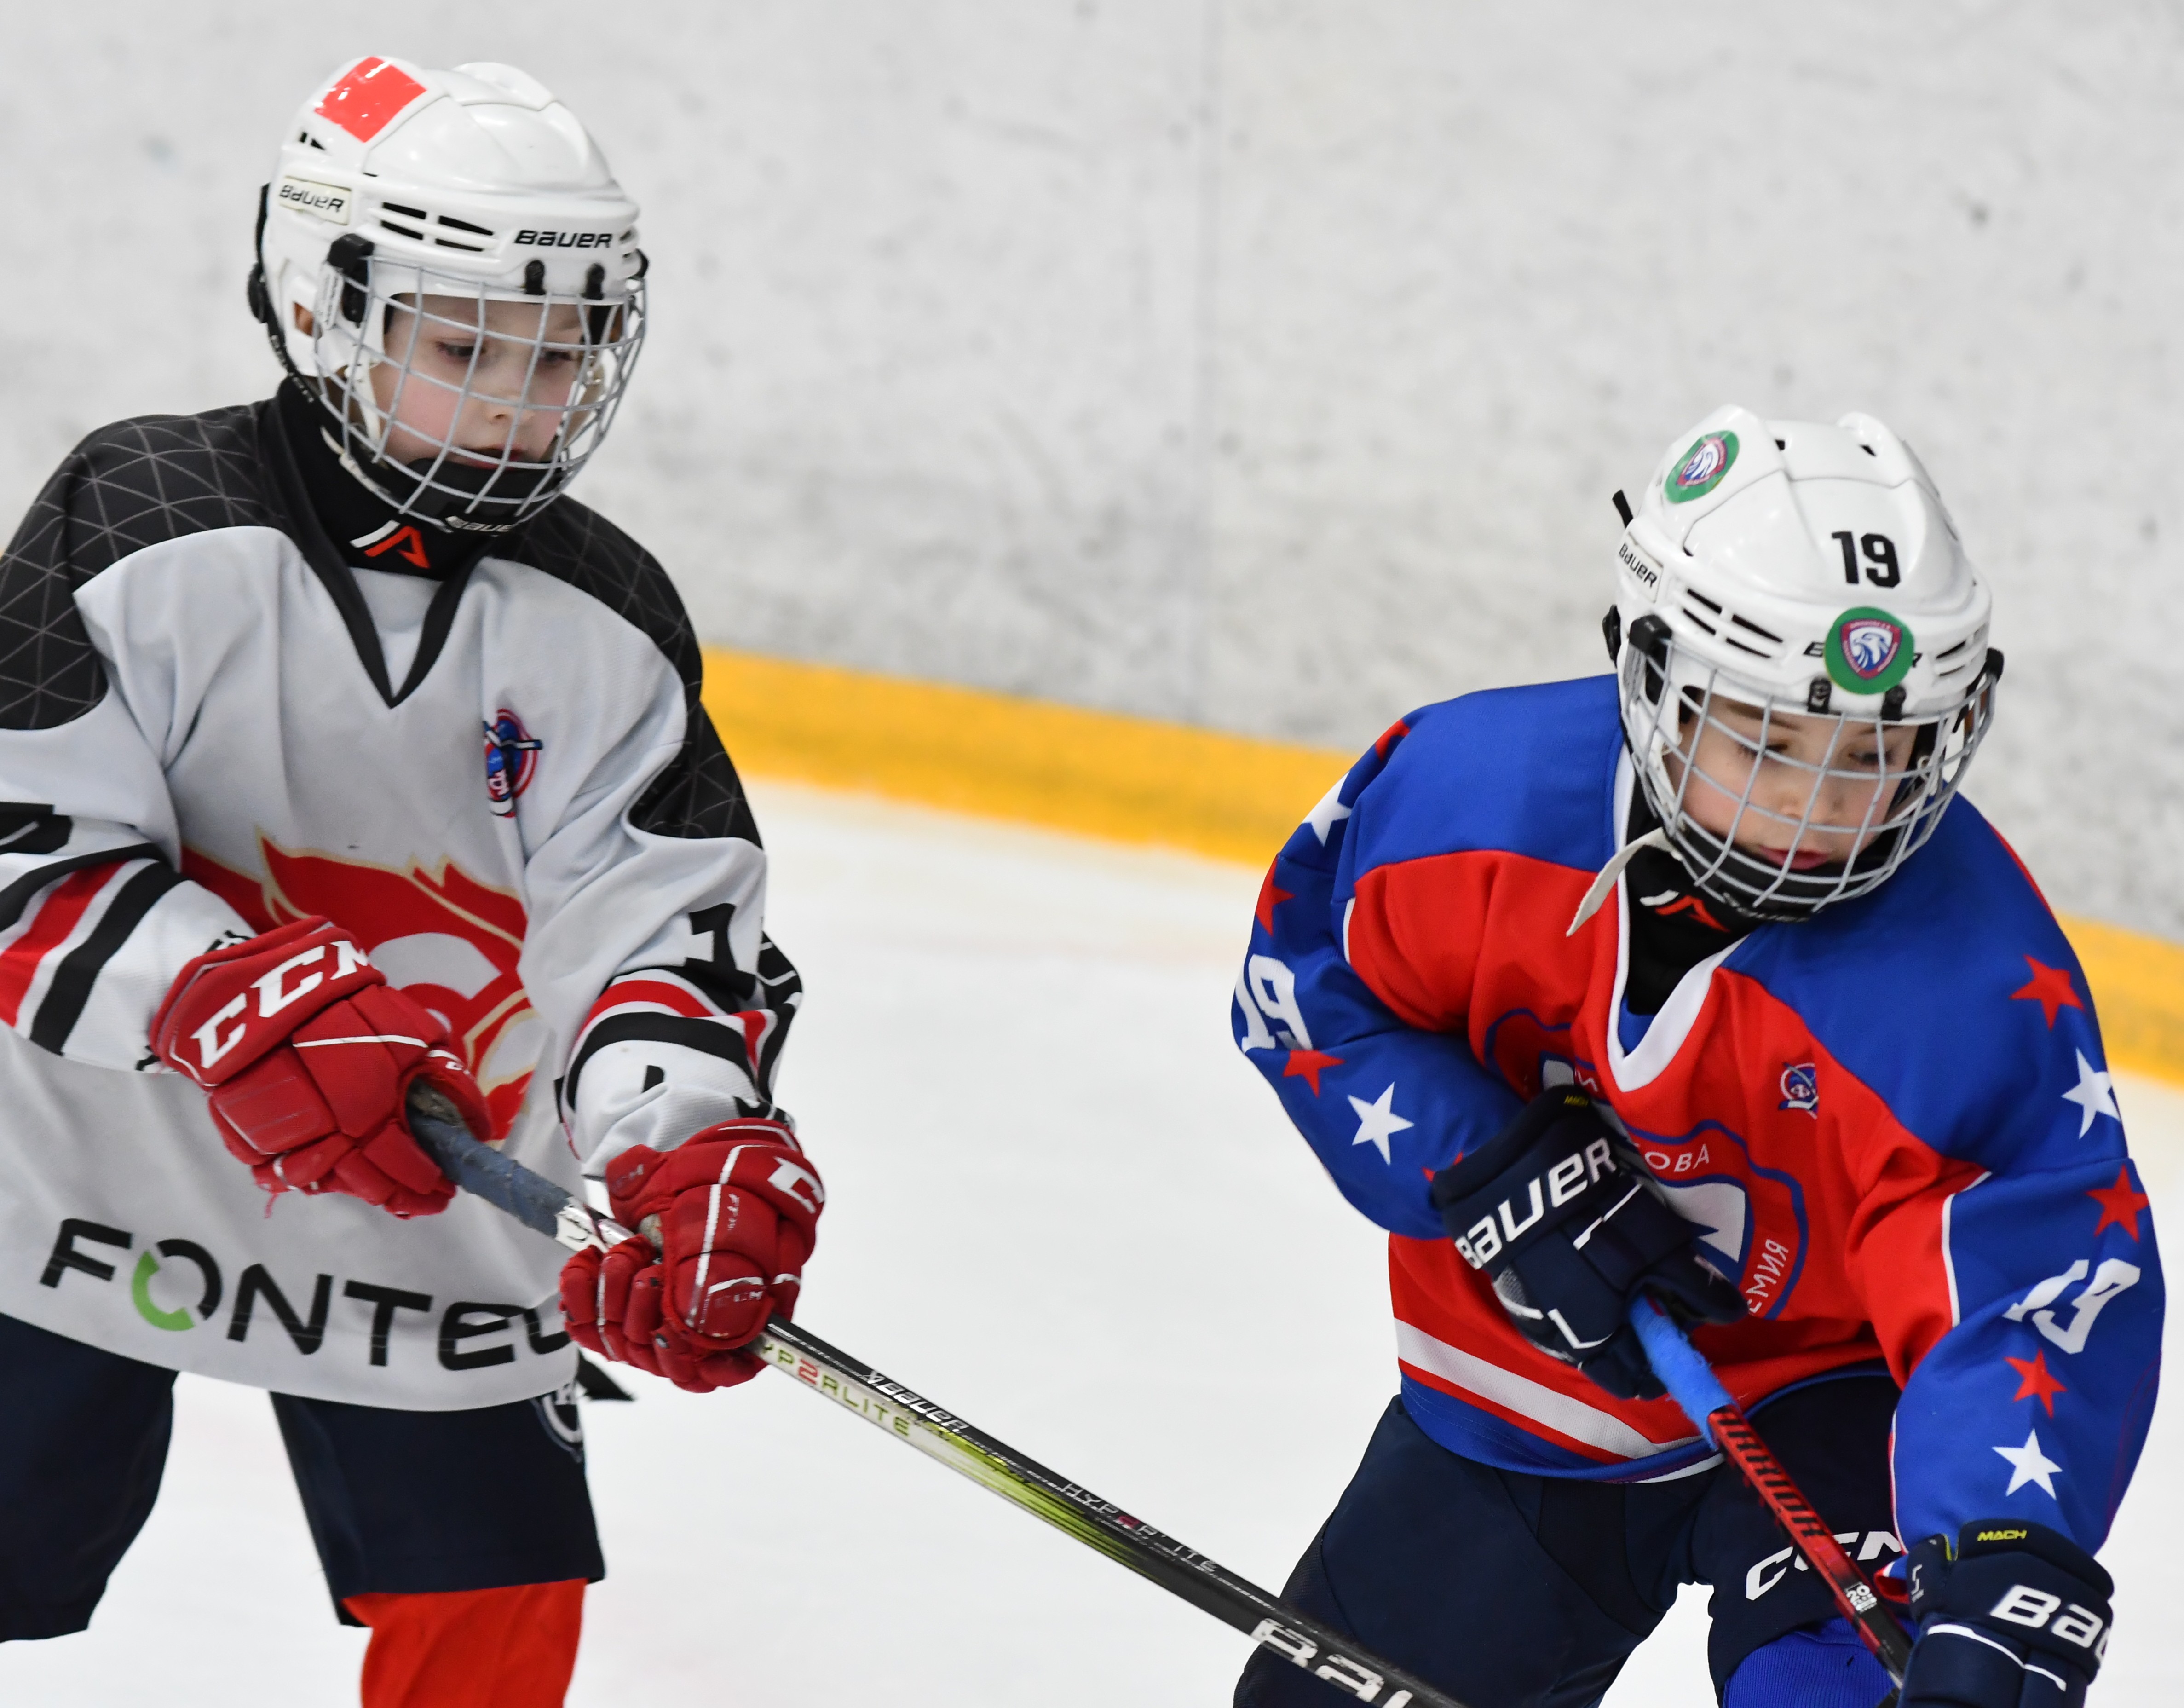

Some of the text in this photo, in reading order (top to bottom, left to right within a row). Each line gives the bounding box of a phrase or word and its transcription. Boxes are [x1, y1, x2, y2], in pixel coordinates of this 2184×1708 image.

[1832, 531, 1901, 589] 19
[1235, 953, 1314, 1053] 19
[2002, 1258, 2141, 1354] 19
